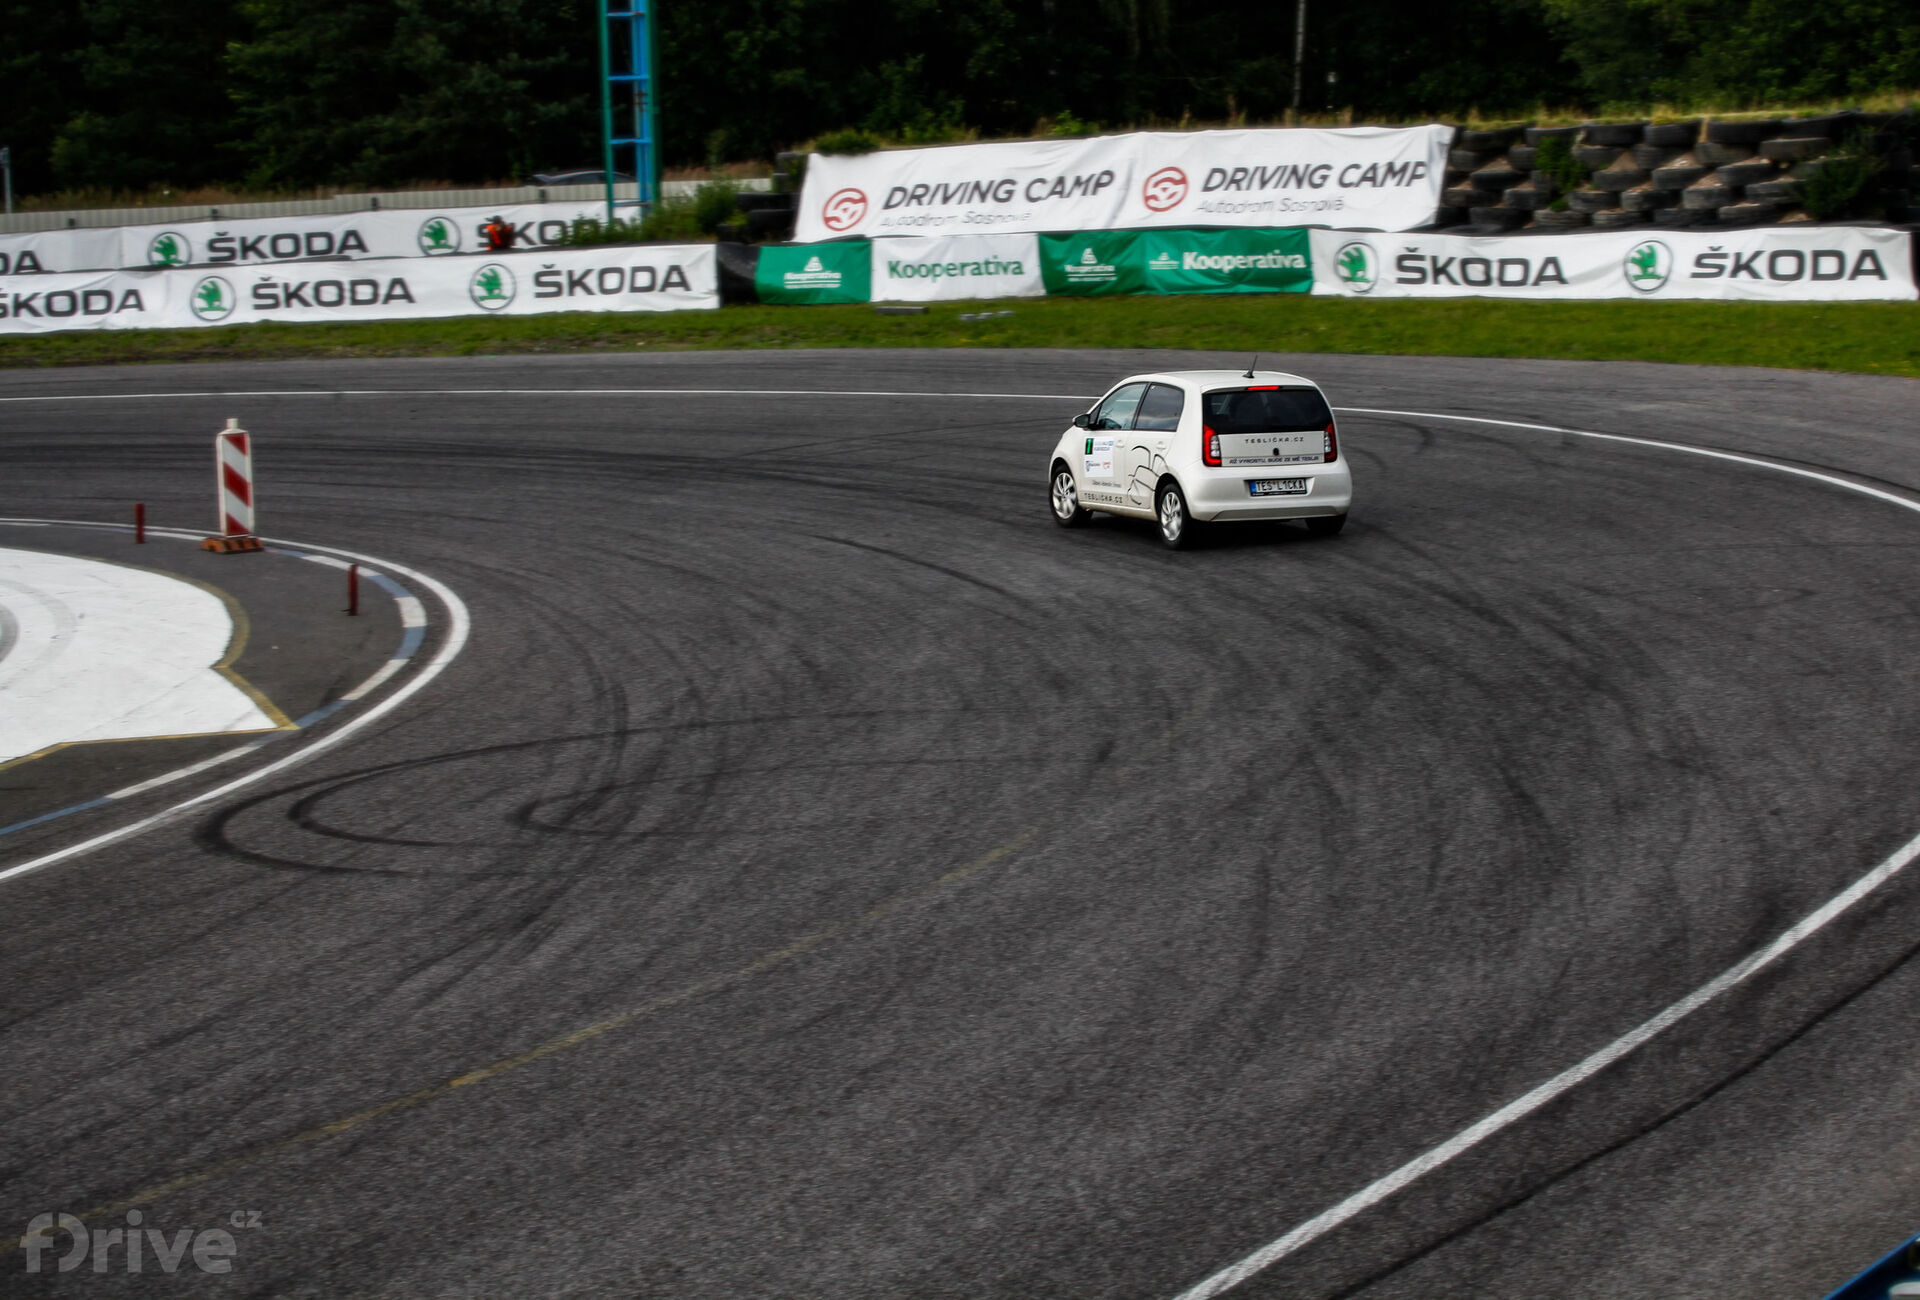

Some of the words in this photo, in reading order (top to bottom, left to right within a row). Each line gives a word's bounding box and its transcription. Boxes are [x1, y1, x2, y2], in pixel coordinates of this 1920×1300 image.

[881, 178, 1018, 210] DRIVING
[1025, 170, 1115, 203] CAMP
[1202, 164, 1333, 193] DRIVING
[1338, 161, 1427, 188] CAMP
[208, 230, 369, 263] ŠKODA
[1182, 250, 1307, 273] Kooperativa
[887, 255, 1025, 282] Kooperativa
[1395, 246, 1569, 287] ŠKODA
[1691, 245, 1887, 282] ŠKODA
[252, 276, 416, 310] ŠKODA
[533, 263, 692, 299] ŠKODA
[1256, 480, 1272, 491] TES
